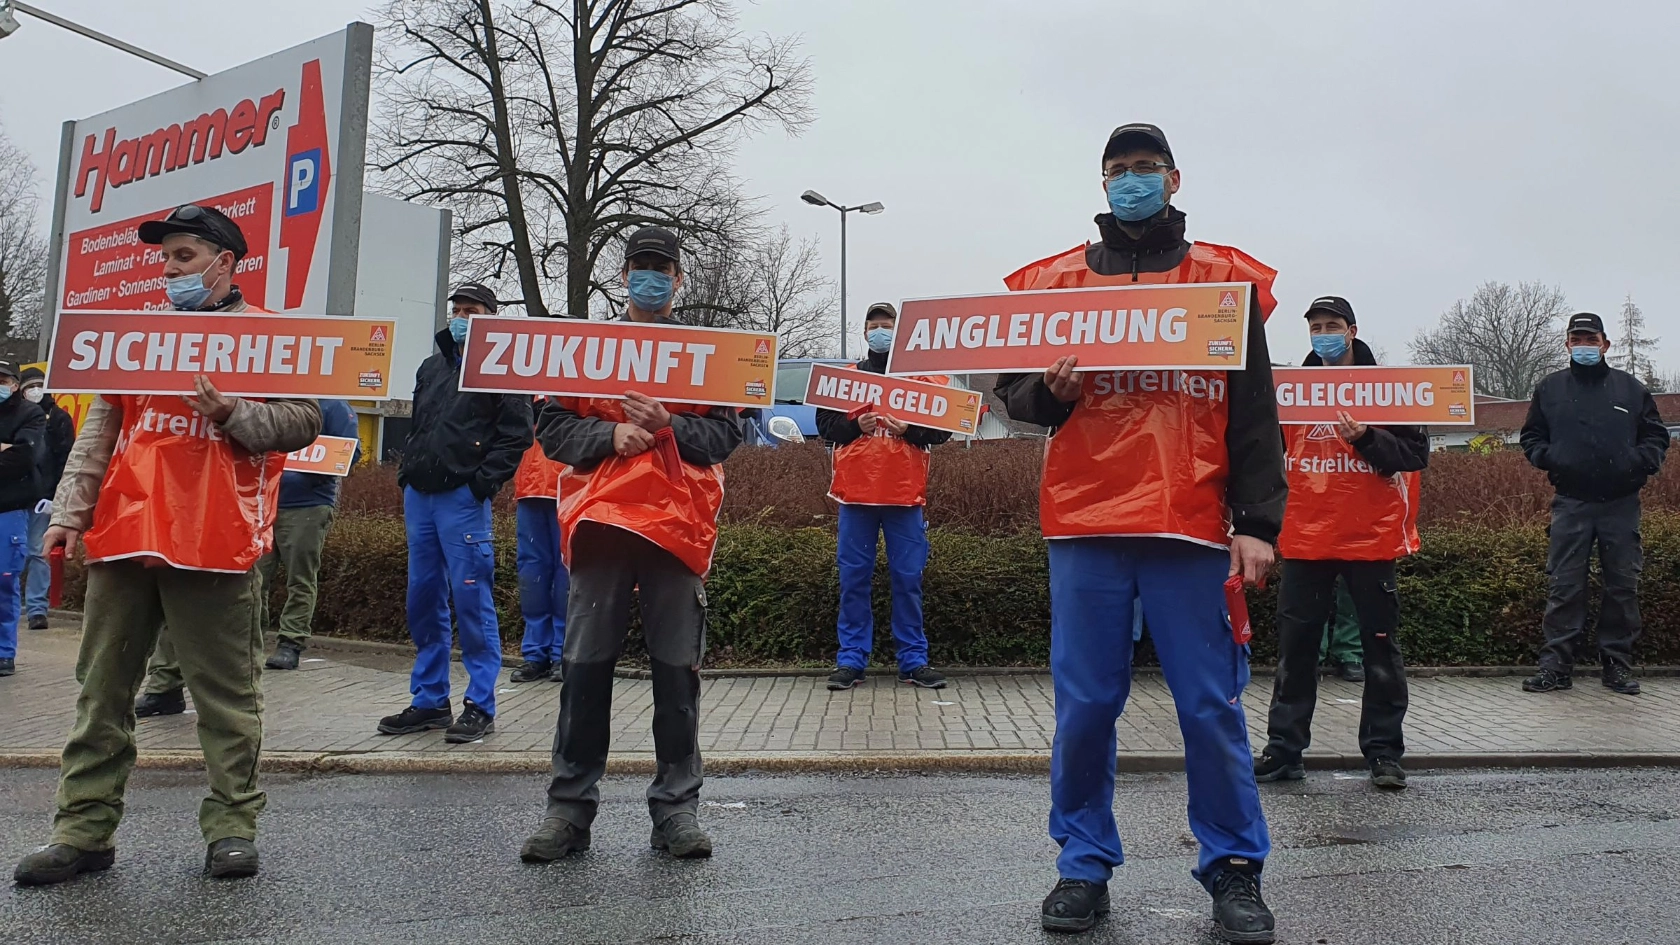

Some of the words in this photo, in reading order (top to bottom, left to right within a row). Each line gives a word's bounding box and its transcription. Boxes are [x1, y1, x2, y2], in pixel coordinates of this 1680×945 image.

[74, 88, 285, 213] Hammer
[290, 158, 315, 208] P
[80, 226, 139, 254] Bodenbeläg
[94, 254, 134, 277] Laminat
[142, 248, 165, 266] Farb
[235, 255, 263, 274] aren
[66, 286, 110, 307] Gardinen
[118, 276, 168, 297] Sonnensc
[905, 307, 1188, 351] ANGLEICHUNG
[68, 331, 343, 375] SICHERHEIT
[480, 332, 716, 386] ZUKUNFT
[816, 374, 883, 406] MEHR
[889, 388, 948, 417] GELD
[1094, 370, 1225, 402] streiken
[1276, 382, 1434, 406] GLEICHUNG
[143, 407, 223, 441] treike
[287, 444, 326, 463] ELD
[1283, 450, 1297, 471] ir
